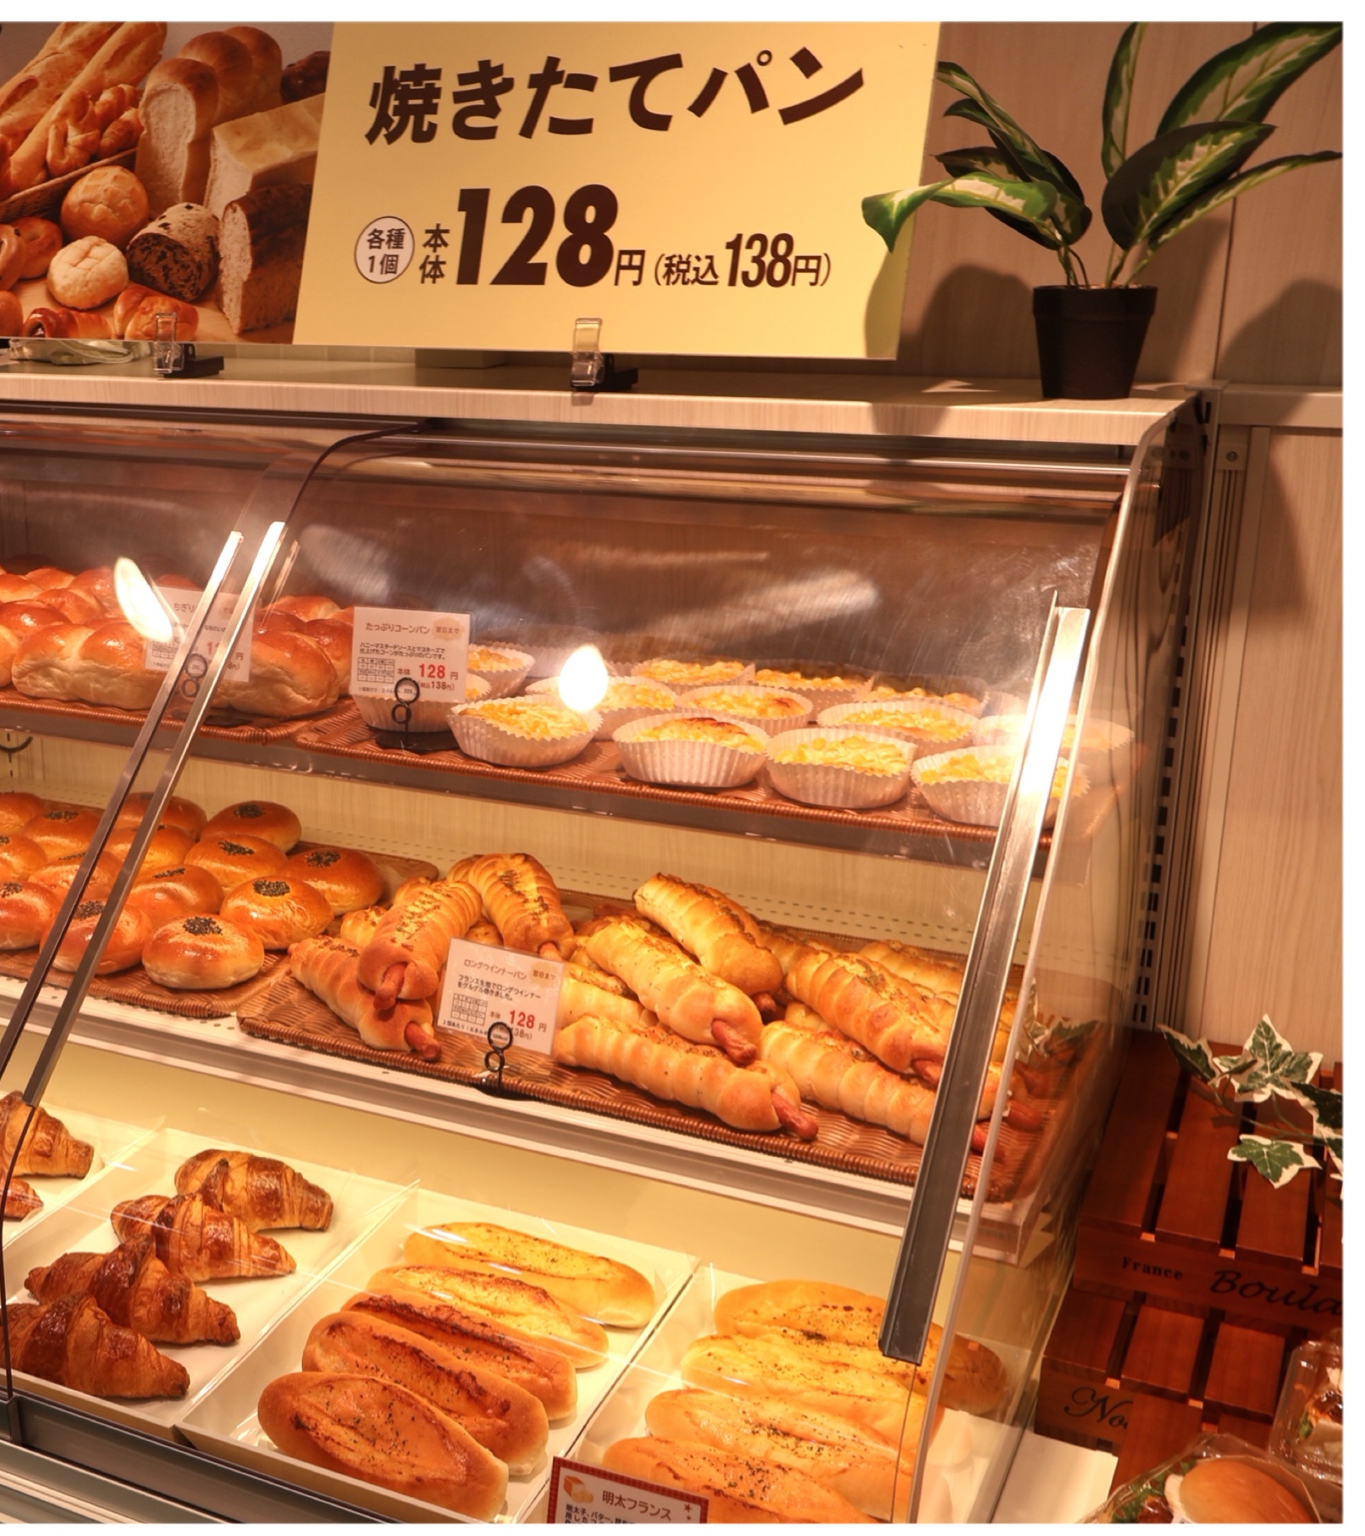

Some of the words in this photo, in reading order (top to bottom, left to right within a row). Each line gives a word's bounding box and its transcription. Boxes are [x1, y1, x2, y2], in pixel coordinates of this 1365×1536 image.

[363, 43, 866, 148] 焼きたてパン
[365, 226, 407, 252] 各種
[365, 252, 402, 279] 1個
[418, 221, 451, 287] 本体
[365, 621, 431, 636] たっぷりコーンパン
[463, 958, 528, 981] ロングウインナーパン
[457, 973, 543, 1000] フランス生地でロングウインナー
[1120, 1255, 1184, 1282] France
[601, 1489, 672, 1522] 明太フランス
